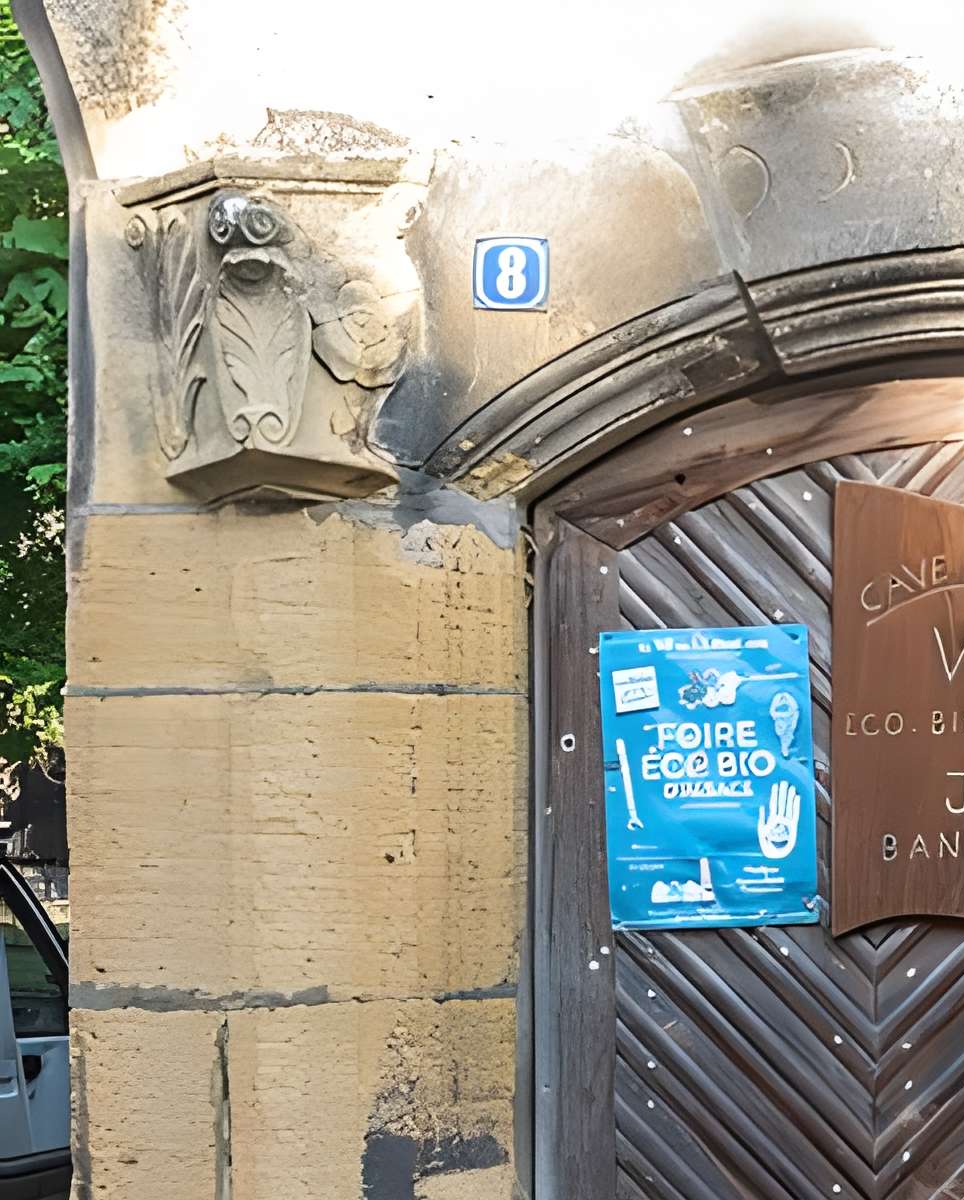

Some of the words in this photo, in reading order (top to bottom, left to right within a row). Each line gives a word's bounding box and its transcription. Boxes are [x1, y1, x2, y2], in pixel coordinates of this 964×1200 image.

[496, 246, 527, 299] 8
[861, 554, 948, 613] CAVE
[656, 720, 758, 750] FOIRE
[717, 749, 776, 777] BIO
